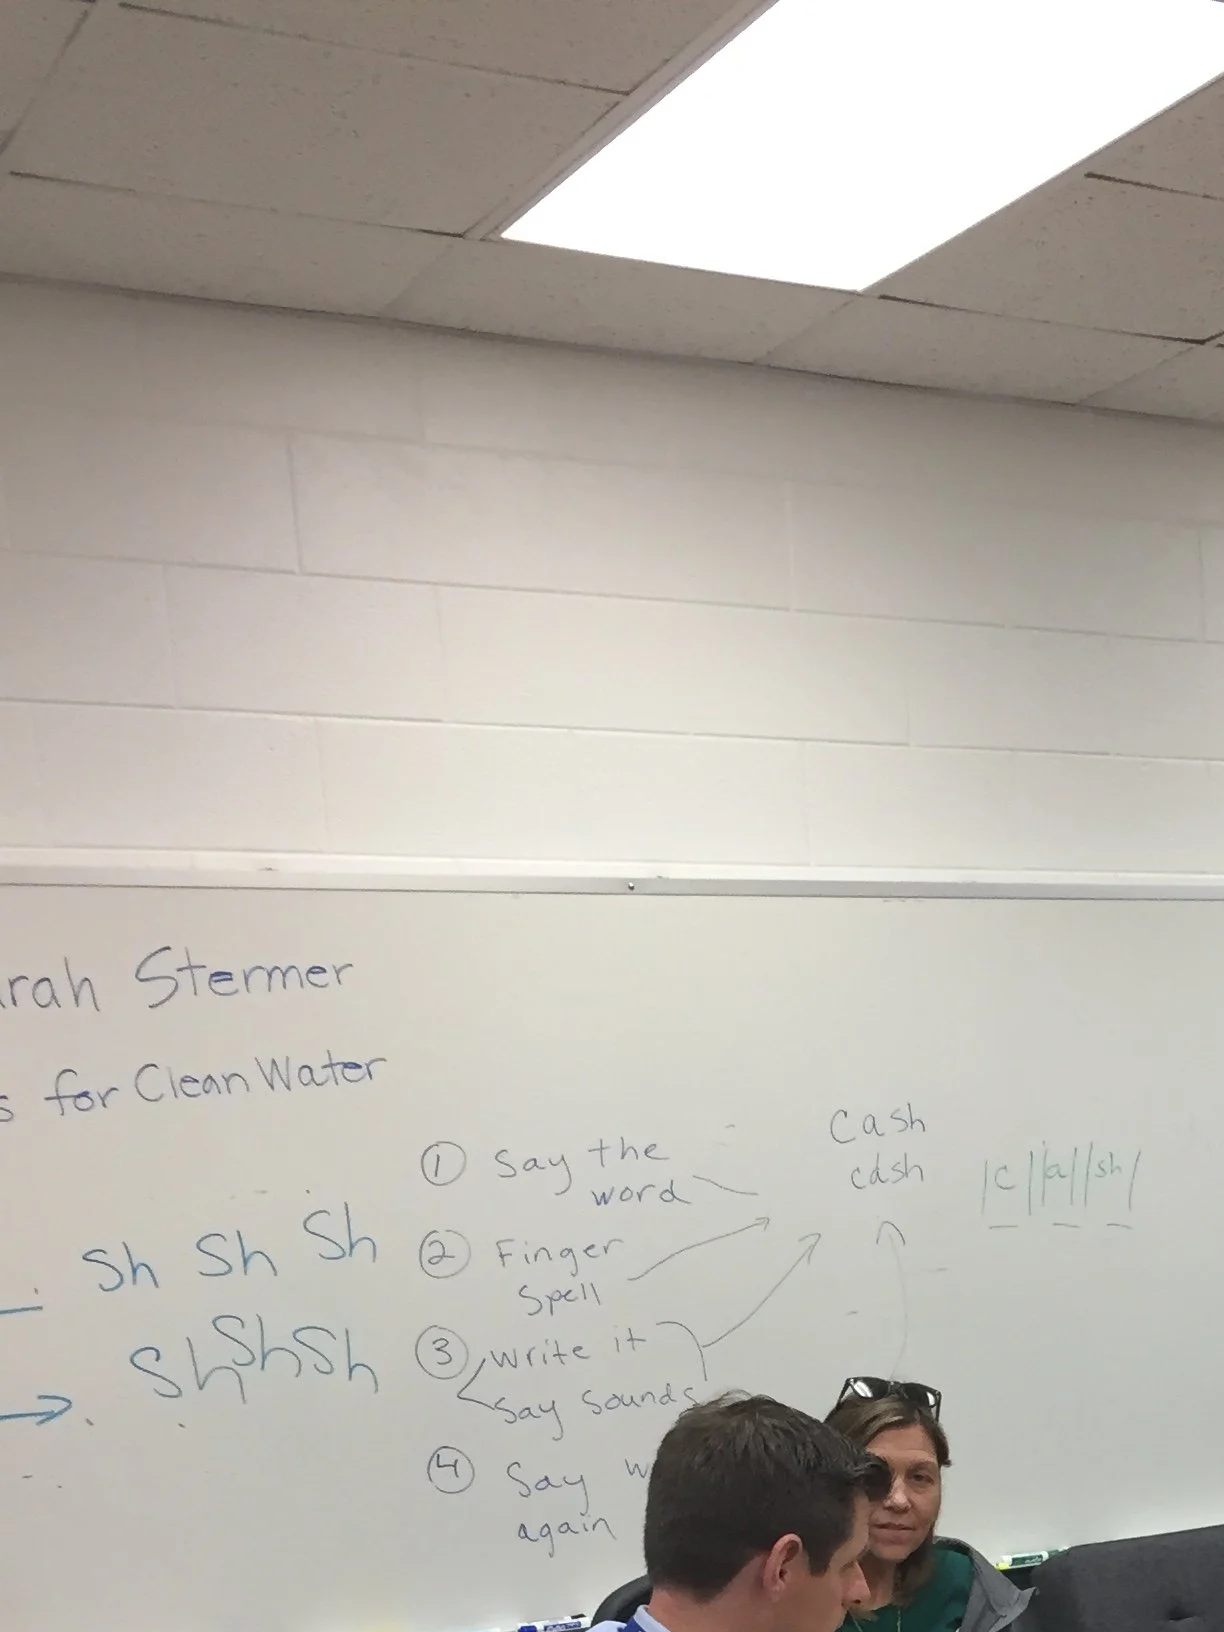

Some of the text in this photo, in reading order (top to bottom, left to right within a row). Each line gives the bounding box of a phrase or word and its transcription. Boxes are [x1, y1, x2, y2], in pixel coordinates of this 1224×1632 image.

[0, 945, 354, 1012] rah Stermer
[44, 1068, 119, 1116] for
[135, 1063, 250, 1102] Clean
[255, 1049, 387, 1092] Water
[587, 1136, 670, 1168] the
[590, 1179, 693, 1207] word
[495, 1238, 624, 1278] Finger
[614, 1326, 647, 1353] it
[517, 1515, 617, 1559] again
